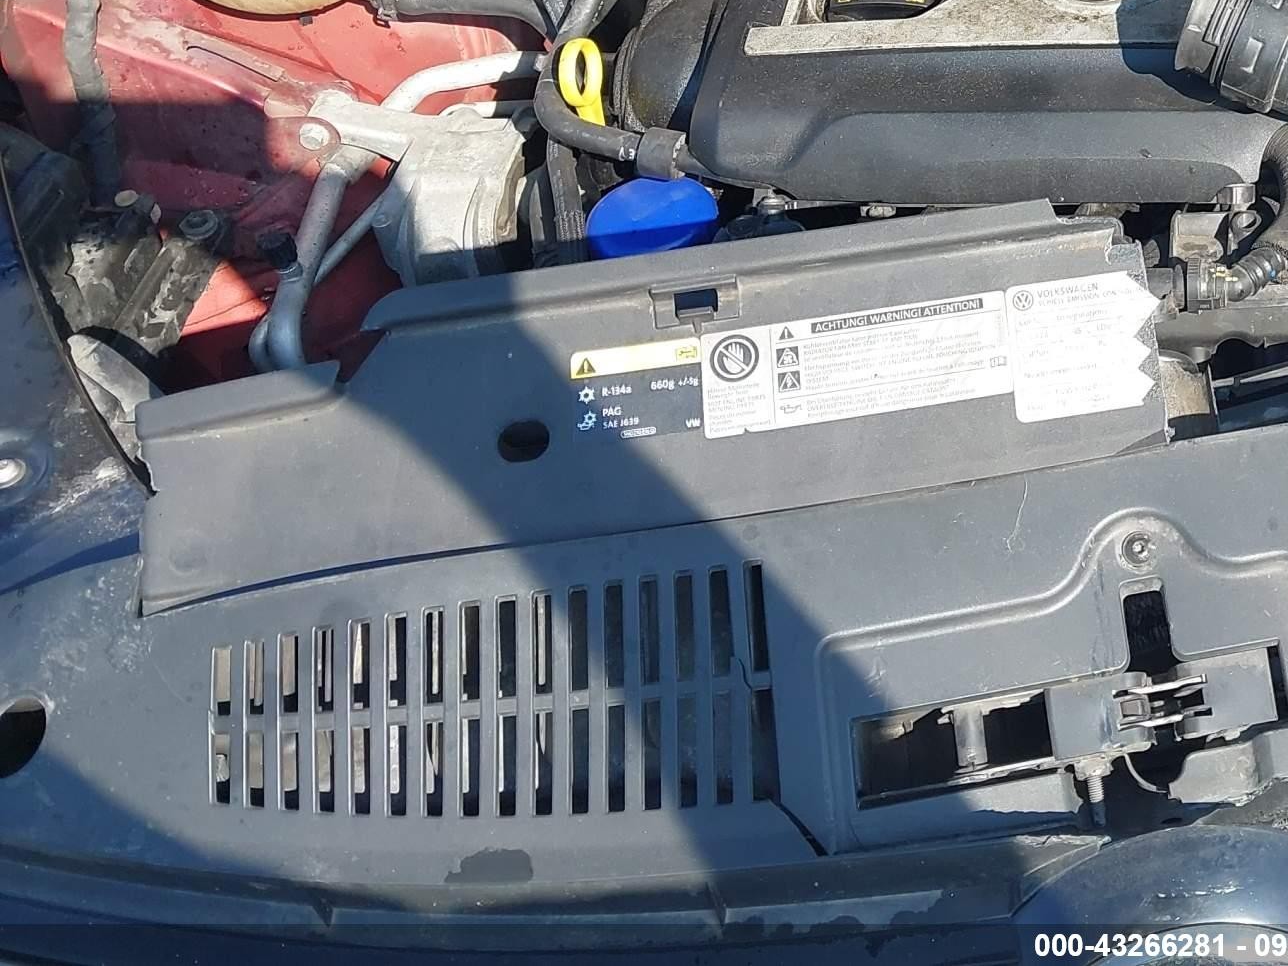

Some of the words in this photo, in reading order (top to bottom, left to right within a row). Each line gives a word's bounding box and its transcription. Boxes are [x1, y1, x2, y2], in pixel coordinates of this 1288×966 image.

[1037, 282, 1099, 298] VOLKSWAGEN
[815, 315, 868, 333] ACHTUNG!
[870, 309, 922, 325] WARNING!
[923, 299, 980, 317] ATTENTION!
[602, 384, 632, 397] R-134a
[650, 379, 675, 391] 660g
[602, 406, 622, 417] PAG
[603, 421, 618, 430] SAE
[620, 417, 639, 427] J639
